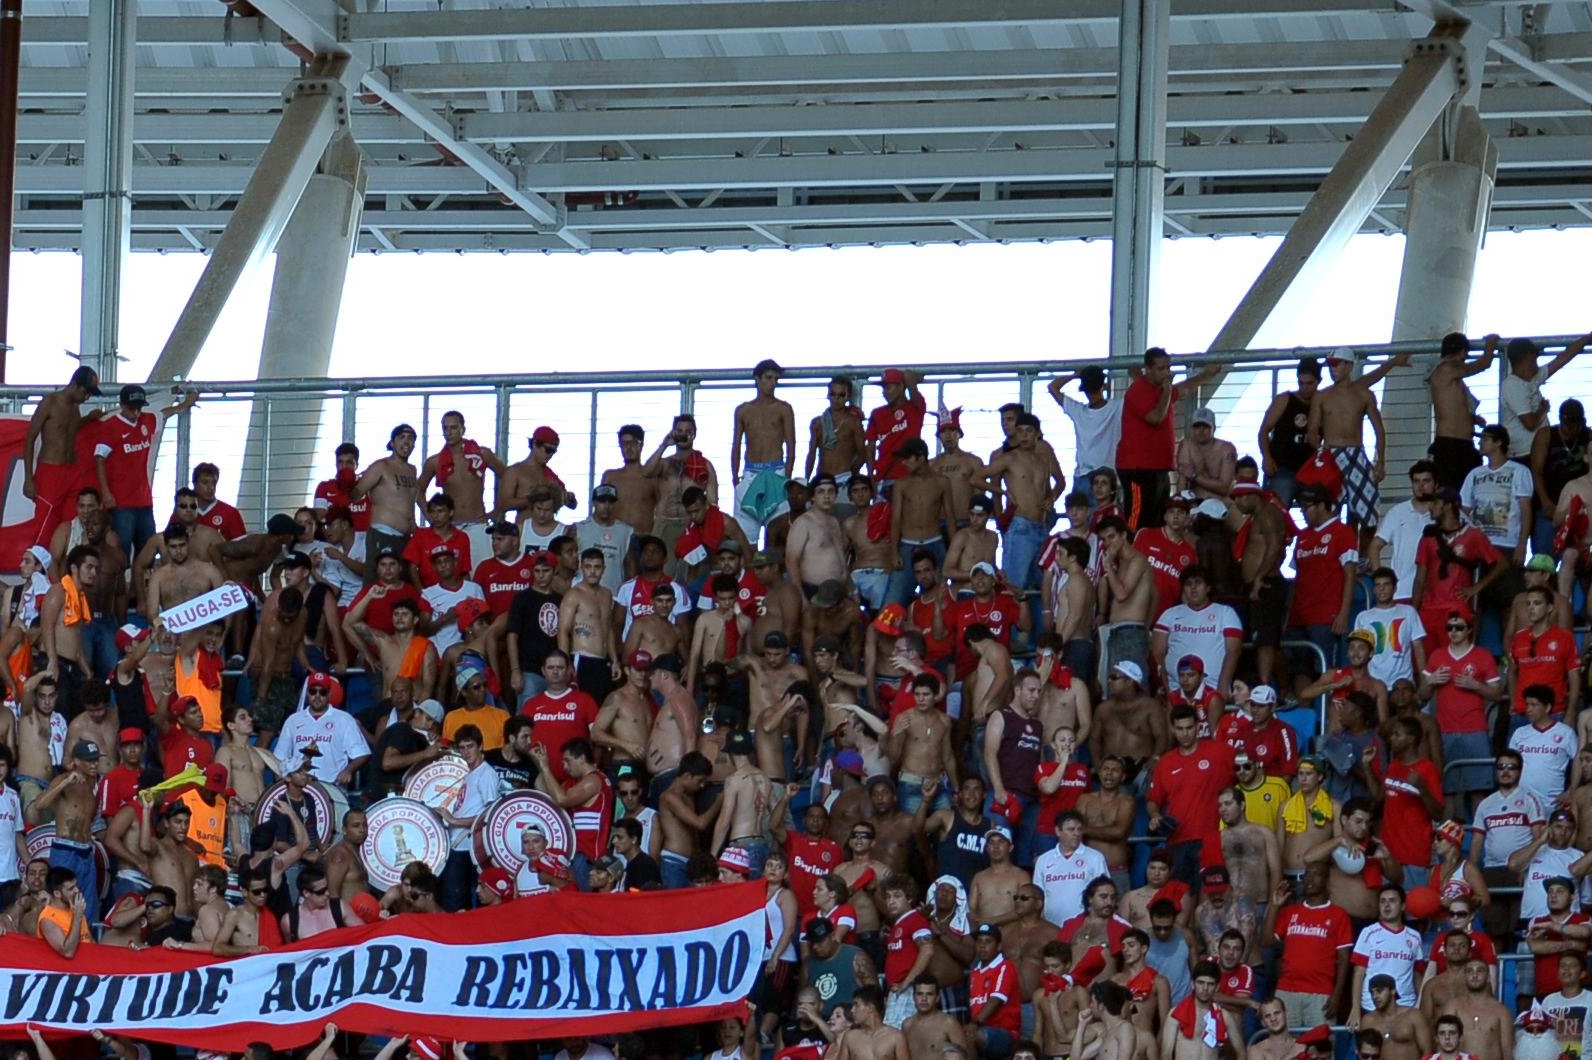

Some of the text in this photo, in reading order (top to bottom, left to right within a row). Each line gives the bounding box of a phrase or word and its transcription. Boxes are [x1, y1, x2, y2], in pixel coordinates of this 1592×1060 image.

[167, 585, 244, 632] ALUGA-SE
[1174, 624, 1216, 634] Banrisul
[1519, 745, 1559, 755] Banrisul
[392, 809, 436, 841] POPULAR
[524, 803, 563, 842] POPULAR
[1045, 874, 1086, 884] Banrisul
[4, 968, 234, 1024] VIRTUDE
[259, 944, 427, 1015] ACABA
[453, 930, 751, 1012] REBAIXADO
